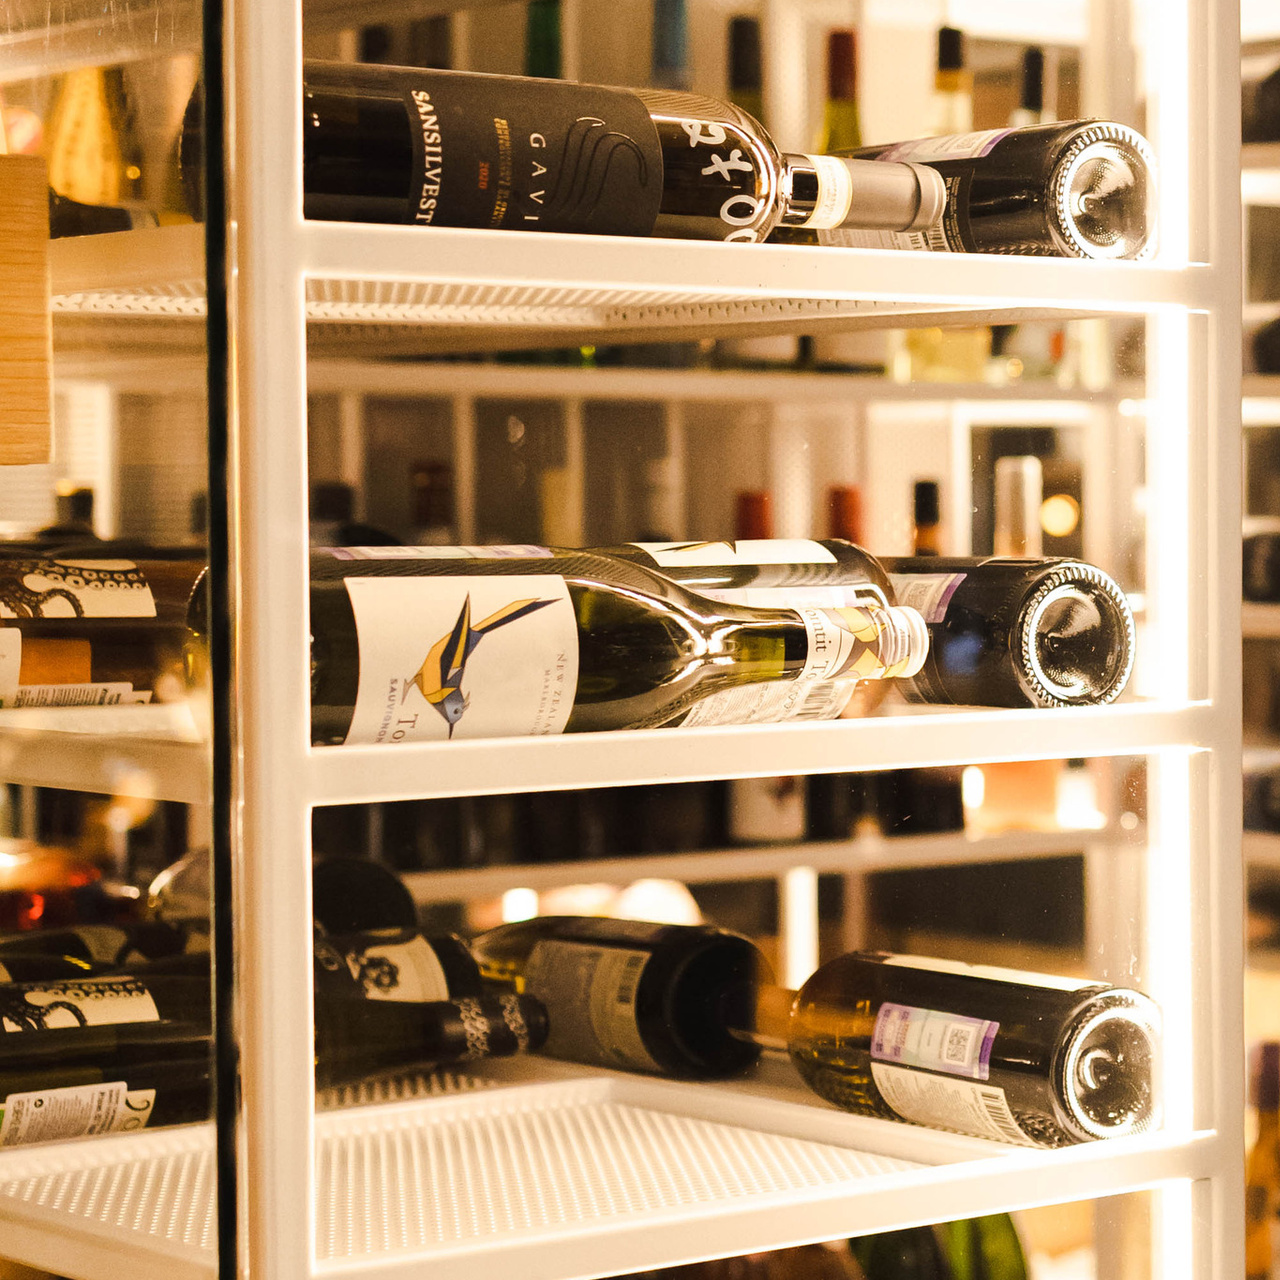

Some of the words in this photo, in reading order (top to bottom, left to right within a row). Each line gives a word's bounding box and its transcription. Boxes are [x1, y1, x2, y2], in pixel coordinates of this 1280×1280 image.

[411, 90, 443, 224] SANSILVEST
[523, 132, 548, 221] GAVI
[556, 653, 567, 682] NEW
[389, 713, 419, 743] To
